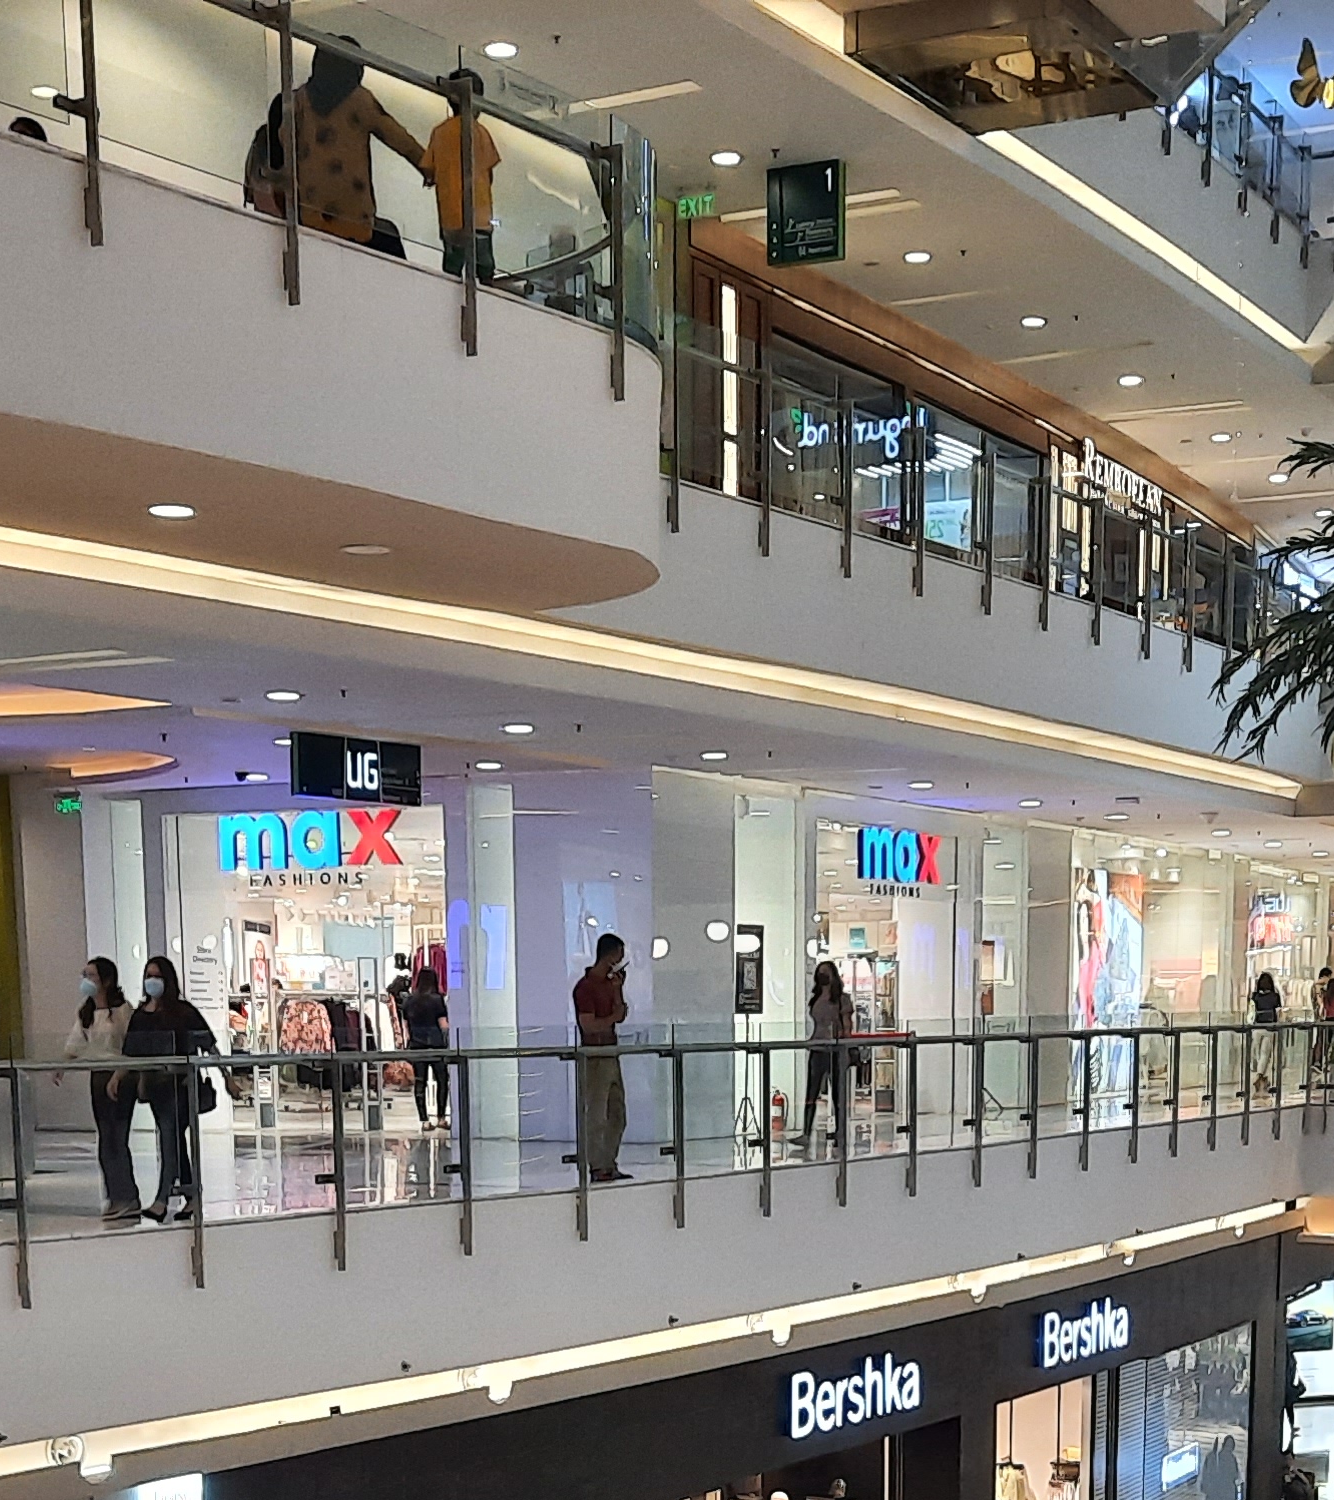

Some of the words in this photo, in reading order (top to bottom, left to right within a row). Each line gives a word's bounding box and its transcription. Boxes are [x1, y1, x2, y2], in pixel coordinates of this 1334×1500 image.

[825, 167, 833, 192] 1
[678, 194, 715, 219] EXIT
[347, 750, 379, 790] UG
[218, 808, 403, 871] max
[857, 826, 942, 884] max
[249, 872, 363, 887] FASHIONS
[870, 884, 922, 898] FASHIONS
[1042, 1297, 1130, 1369] Bershka
[789, 1352, 921, 1440] Bershka
